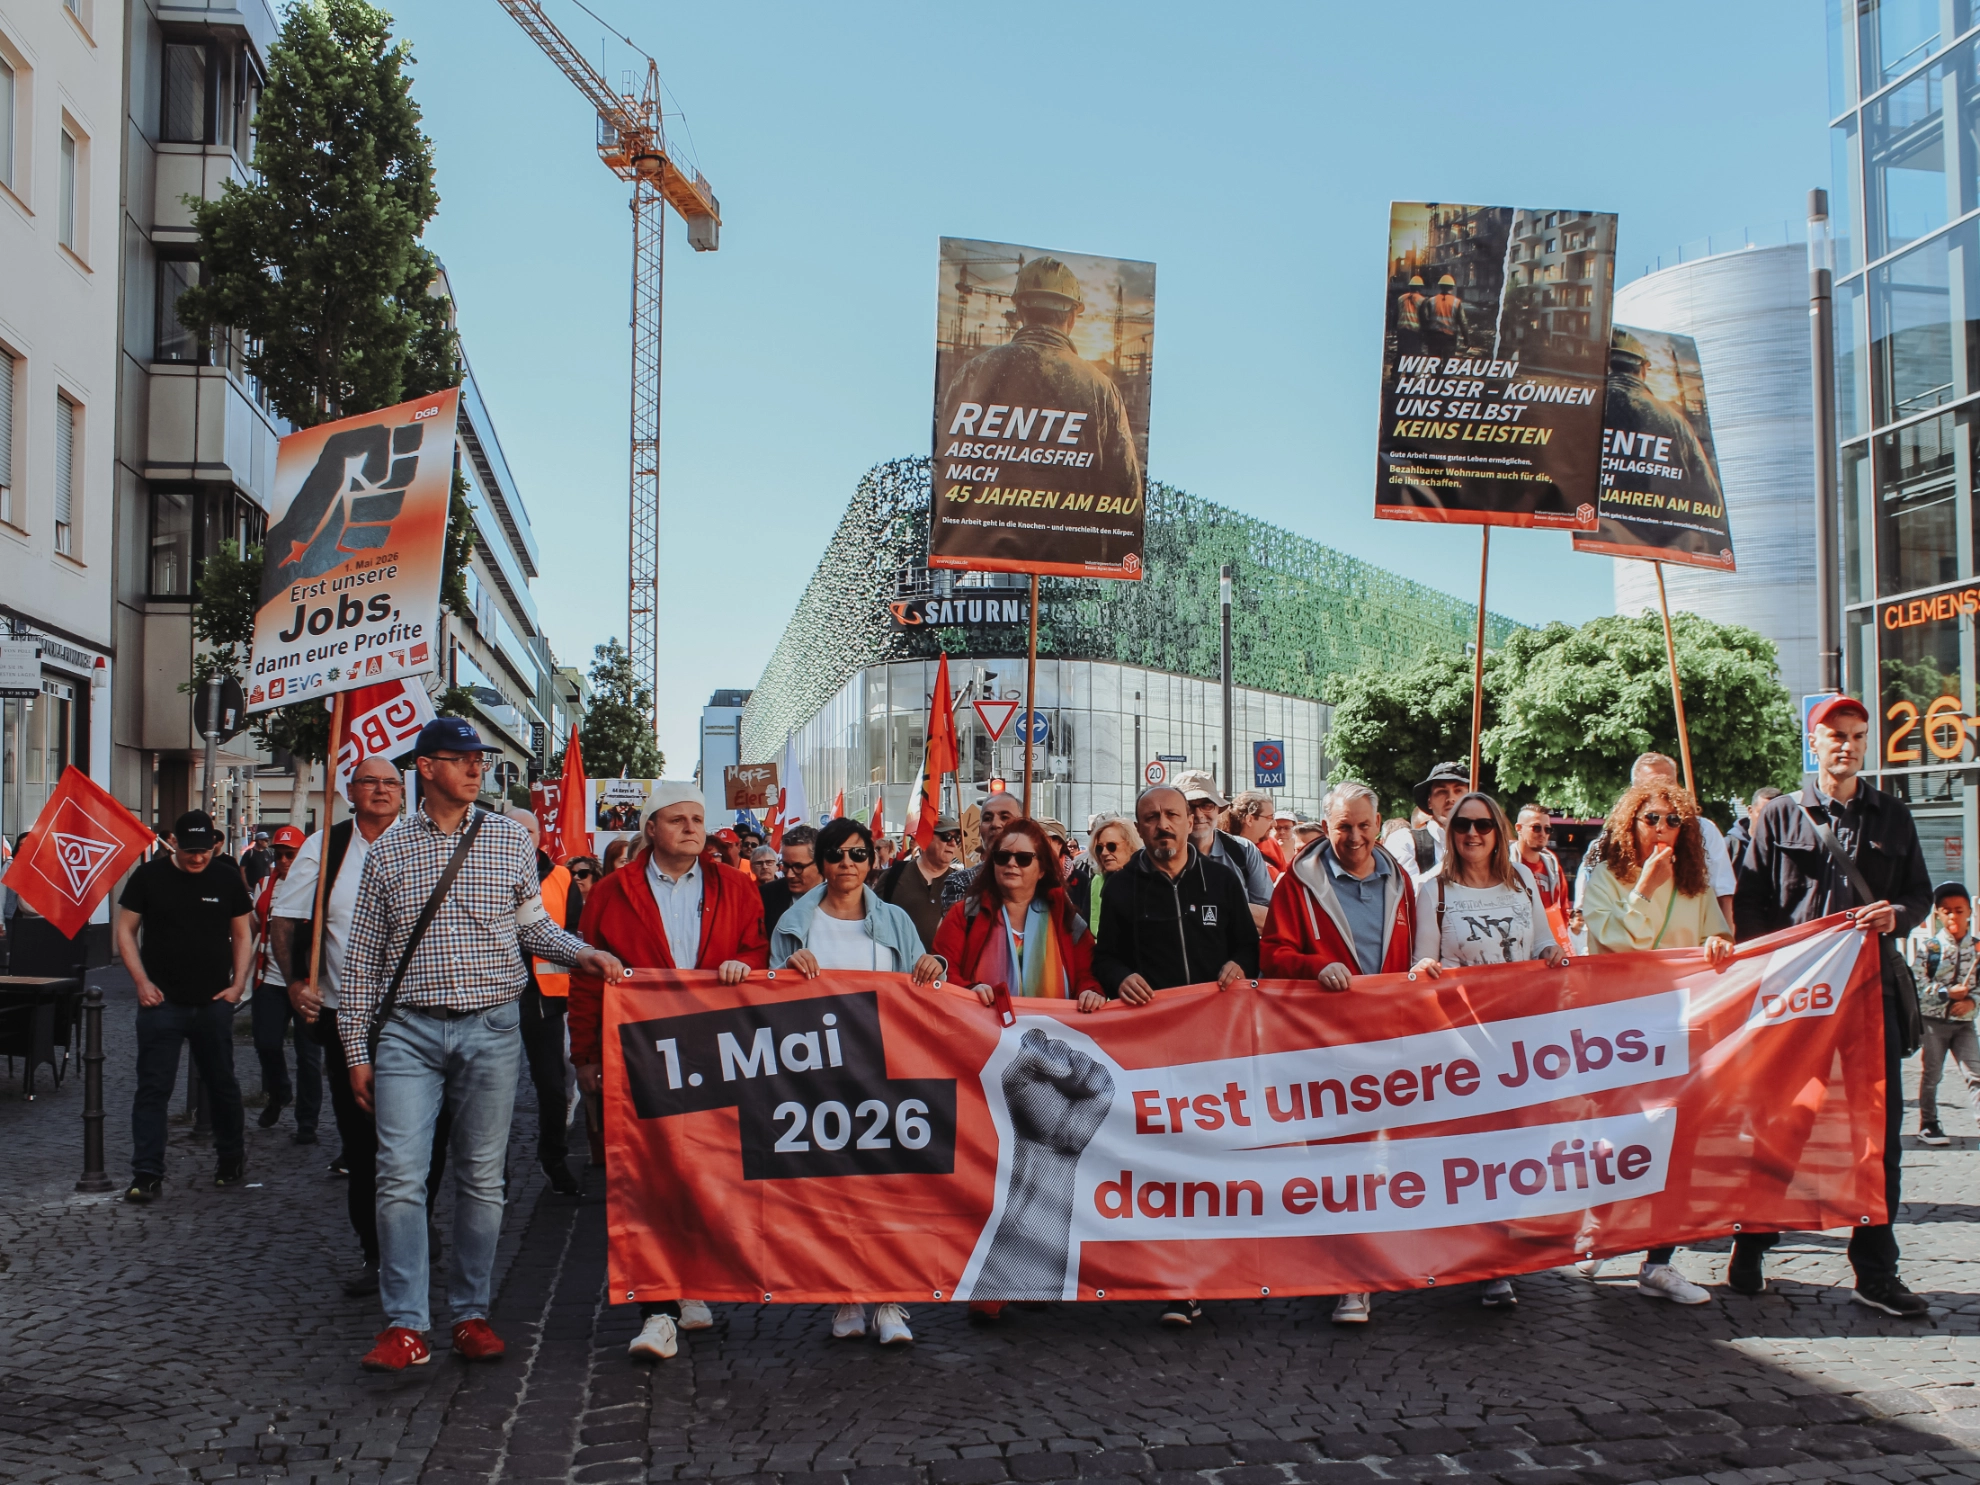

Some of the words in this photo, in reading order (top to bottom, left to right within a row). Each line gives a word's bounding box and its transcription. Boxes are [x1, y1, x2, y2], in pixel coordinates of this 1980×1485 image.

[1398, 356, 1440, 374] WIR
[1442, 357, 1520, 378] BAUEN
[1395, 374, 1484, 397] HÄUSER
[1503, 380, 1596, 406] KÖNNEN
[414, 406, 439, 420] DGB
[1395, 398, 1441, 418] UNS
[1444, 400, 1528, 422] SELBST
[948, 402, 1088, 445] RENTE
[1393, 420, 1460, 441] KEINS
[1462, 423, 1552, 446] LEISTEN
[944, 442, 1094, 468] ABSCHLAGSFREI
[1390, 451, 1406, 459] Gute
[1406, 452, 1428, 460] Arbeit
[1448, 454, 1466, 462] gutes
[1467, 455, 1488, 463] Leben
[1488, 456, 1532, 466] ermöglichen.
[945, 464, 999, 483] NACH
[1388, 475, 1403, 484] die
[1404, 476, 1419, 485] ihn
[1421, 478, 1462, 488] schaffen.
[1389, 464, 1444, 476] Bezahlbarer
[1446, 468, 1494, 478] Wohnraum
[1496, 471, 1518, 480] auch
[1520, 471, 1534, 481] für
[1536, 472, 1553, 484] die,
[944, 486, 972, 502] 45
[974, 487, 1060, 509] JAHREN
[1060, 494, 1094, 512] AM
[1095, 496, 1140, 515] BAU
[1600, 489, 1665, 508] JAHREN
[1666, 498, 1690, 513] AM
[1692, 502, 1722, 519] BAU
[942, 516, 960, 525] Diese
[960, 518, 982, 526] Arbeit
[982, 519, 998, 528] geht
[1006, 520, 1017, 528] die
[1018, 521, 1046, 530] Knochen
[1100, 527, 1112, 535] den
[1112, 528, 1135, 537] Körper.
[344, 563, 352, 572] 1.
[356, 558, 374, 570] Mai
[376, 552, 400, 566] 2026
[290, 580, 326, 603] Erst
[332, 566, 398, 592] unsere
[279, 593, 400, 643] Jobs,
[924, 600, 1018, 623] SATURN
[1884, 589, 1980, 630] CLEMENS
[256, 653, 300, 676] dann
[306, 639, 348, 664] eure
[354, 622, 422, 652] Profite
[288, 673, 322, 694] EVG
[1149, 768, 1162, 780] 20
[1257, 773, 1283, 784] TAXI
[1568, 834, 1574, 842] 7
[1761, 982, 1834, 1019] DGB
[655, 1037, 703, 1090] 1.
[718, 1013, 844, 1083] Mai
[1132, 1082, 1251, 1136] Erst
[1265, 1058, 1481, 1123] unsere
[1497, 1027, 1666, 1089] Jobs,
[773, 1098, 932, 1153] 2026
[1094, 1170, 1263, 1219] dann
[1282, 1170, 1426, 1216] eure
[1442, 1138, 1652, 1205] Profite
